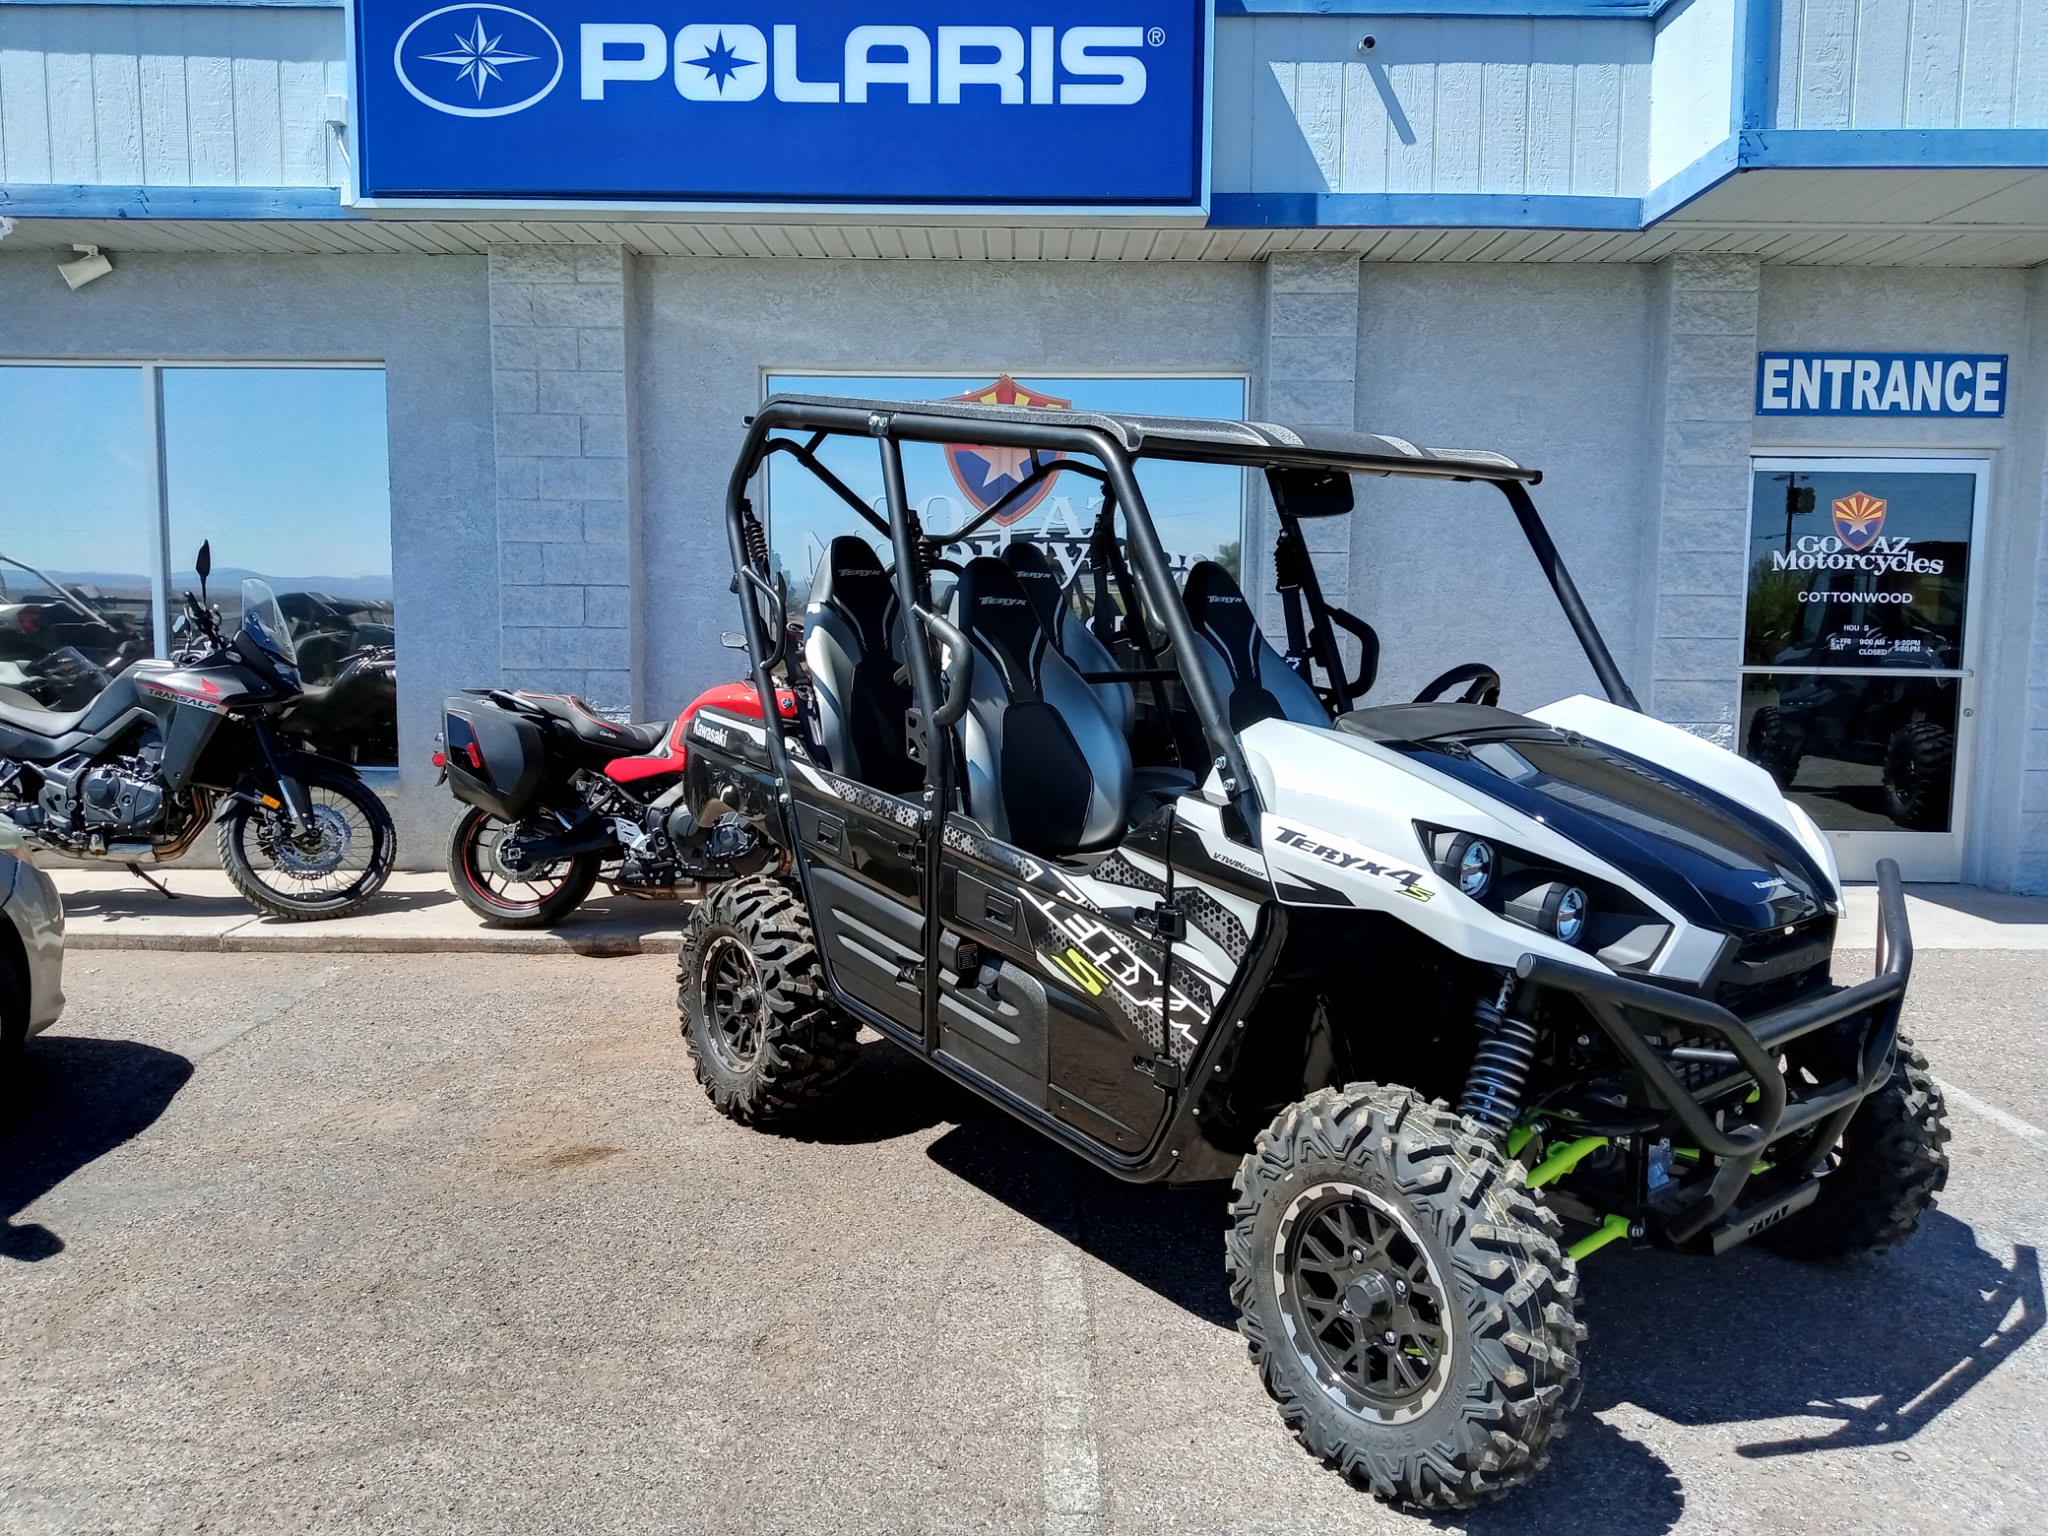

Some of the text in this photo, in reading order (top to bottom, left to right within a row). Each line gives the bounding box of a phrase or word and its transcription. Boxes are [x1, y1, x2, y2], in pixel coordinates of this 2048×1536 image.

[580, 23, 1147, 106] POLARIS
[1761, 358, 2002, 413] ENTRANCE
[1796, 536, 1911, 555] GO AZ
[1771, 549, 1945, 576] Motorcycles
[1797, 591, 1914, 604] COTTONWOOD
[1858, 648, 1888, 656] CLOSED
[148, 687, 218, 710] TRANSALP
[692, 717, 729, 748] Kawasaki
